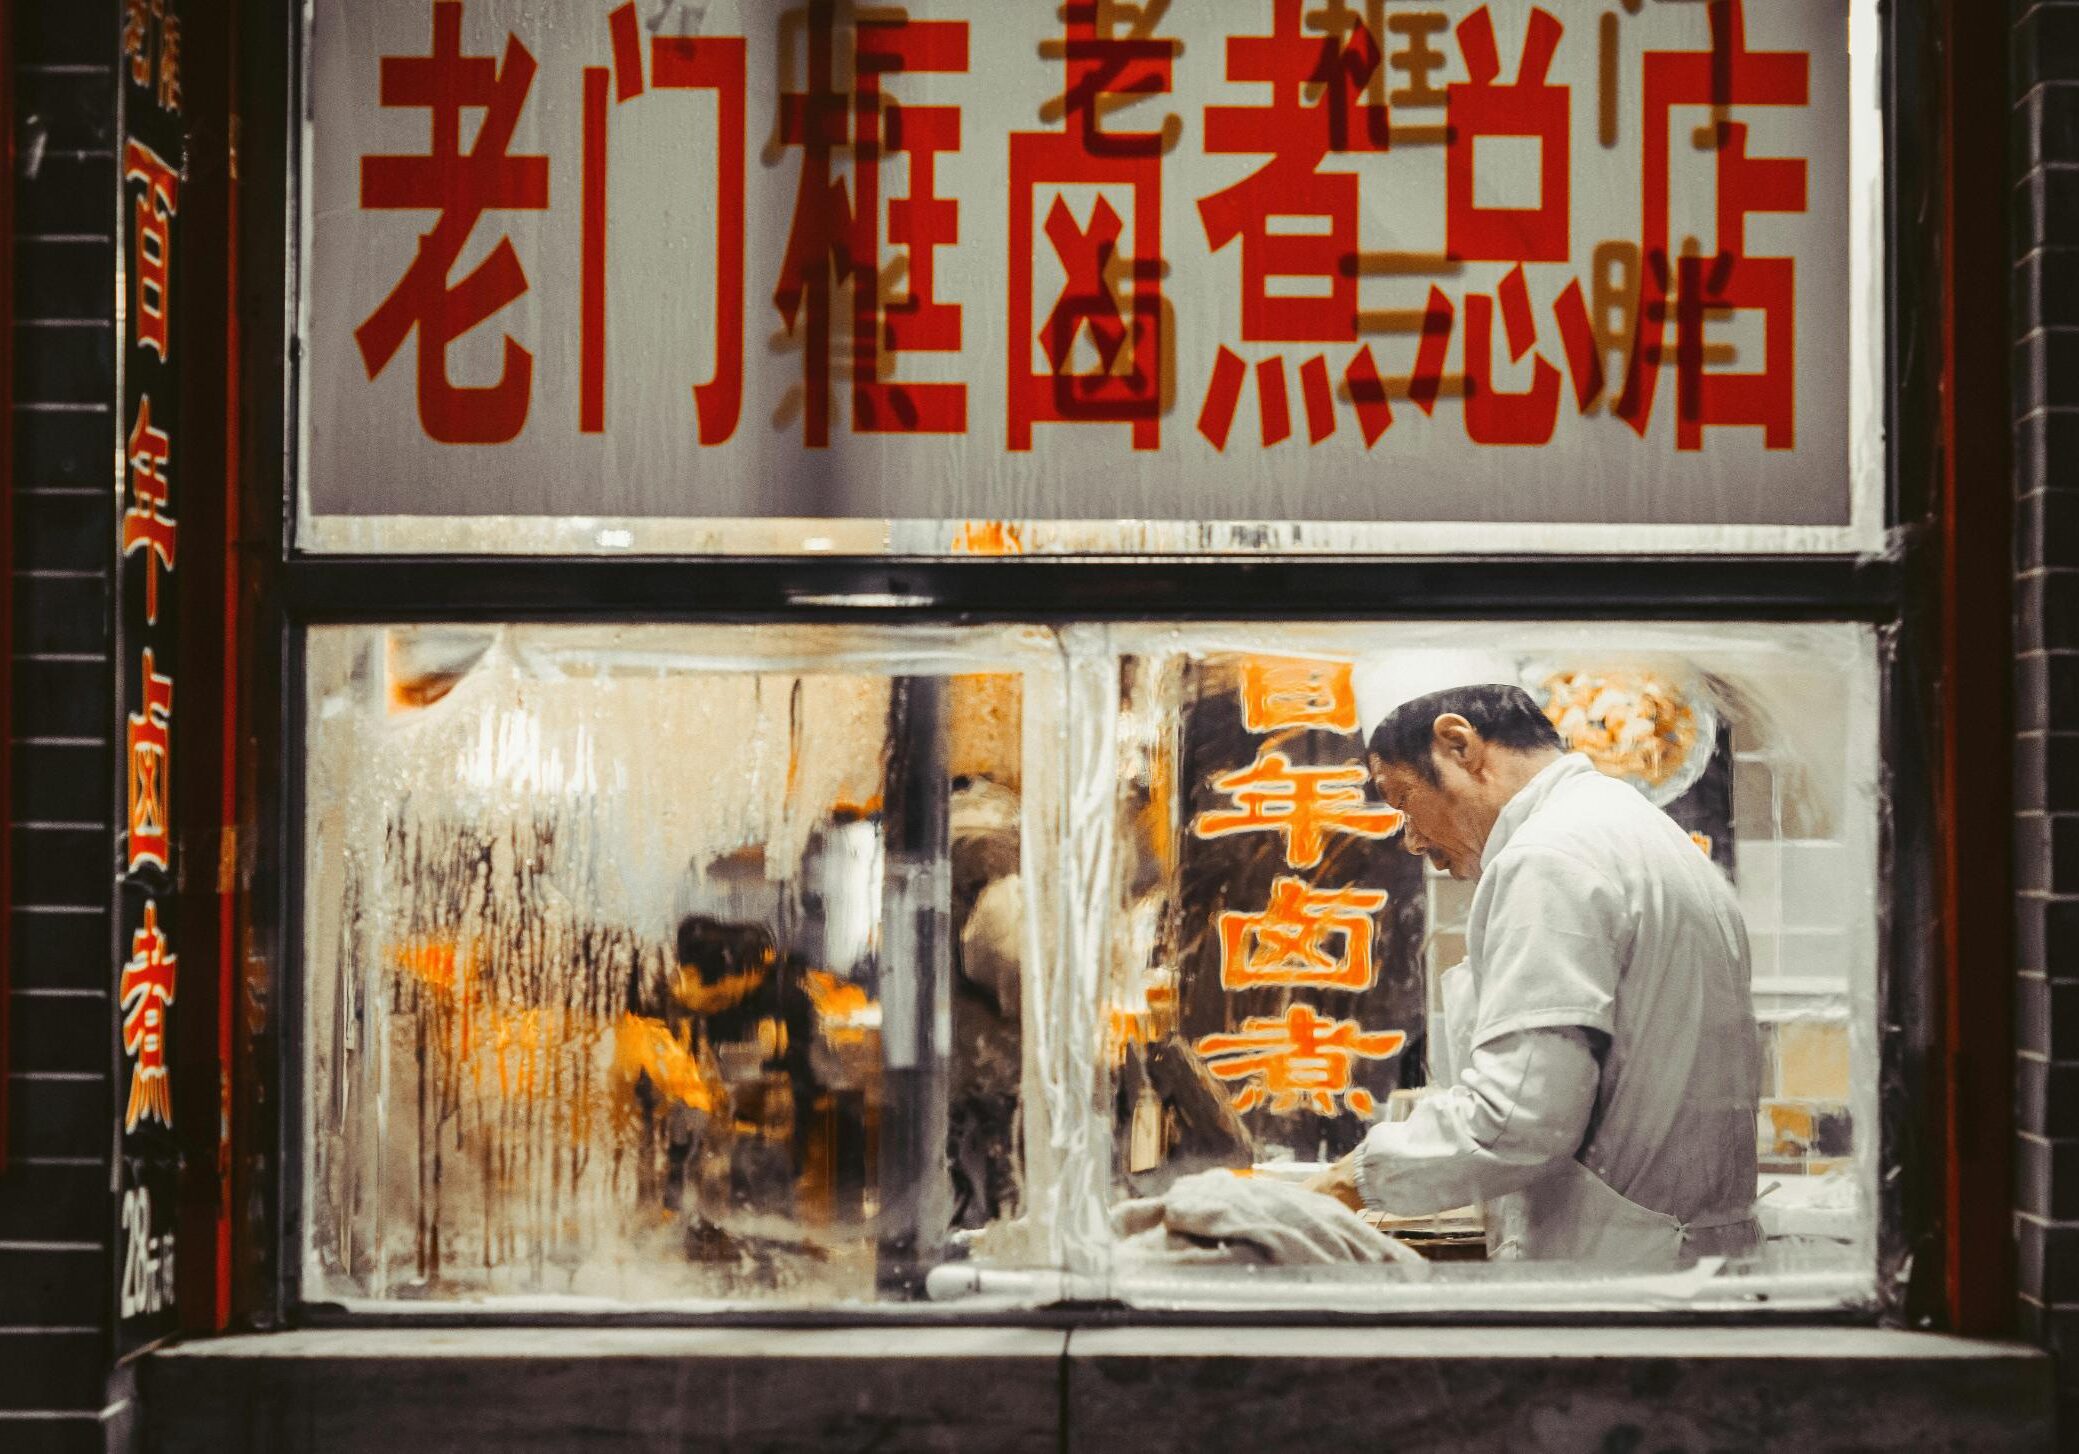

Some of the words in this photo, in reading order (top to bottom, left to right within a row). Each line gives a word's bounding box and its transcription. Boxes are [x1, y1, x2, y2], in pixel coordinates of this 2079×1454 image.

[353, 0, 1812, 452] 老门框卤煮总店
[119, 135, 180, 1134] 百年卤煮
